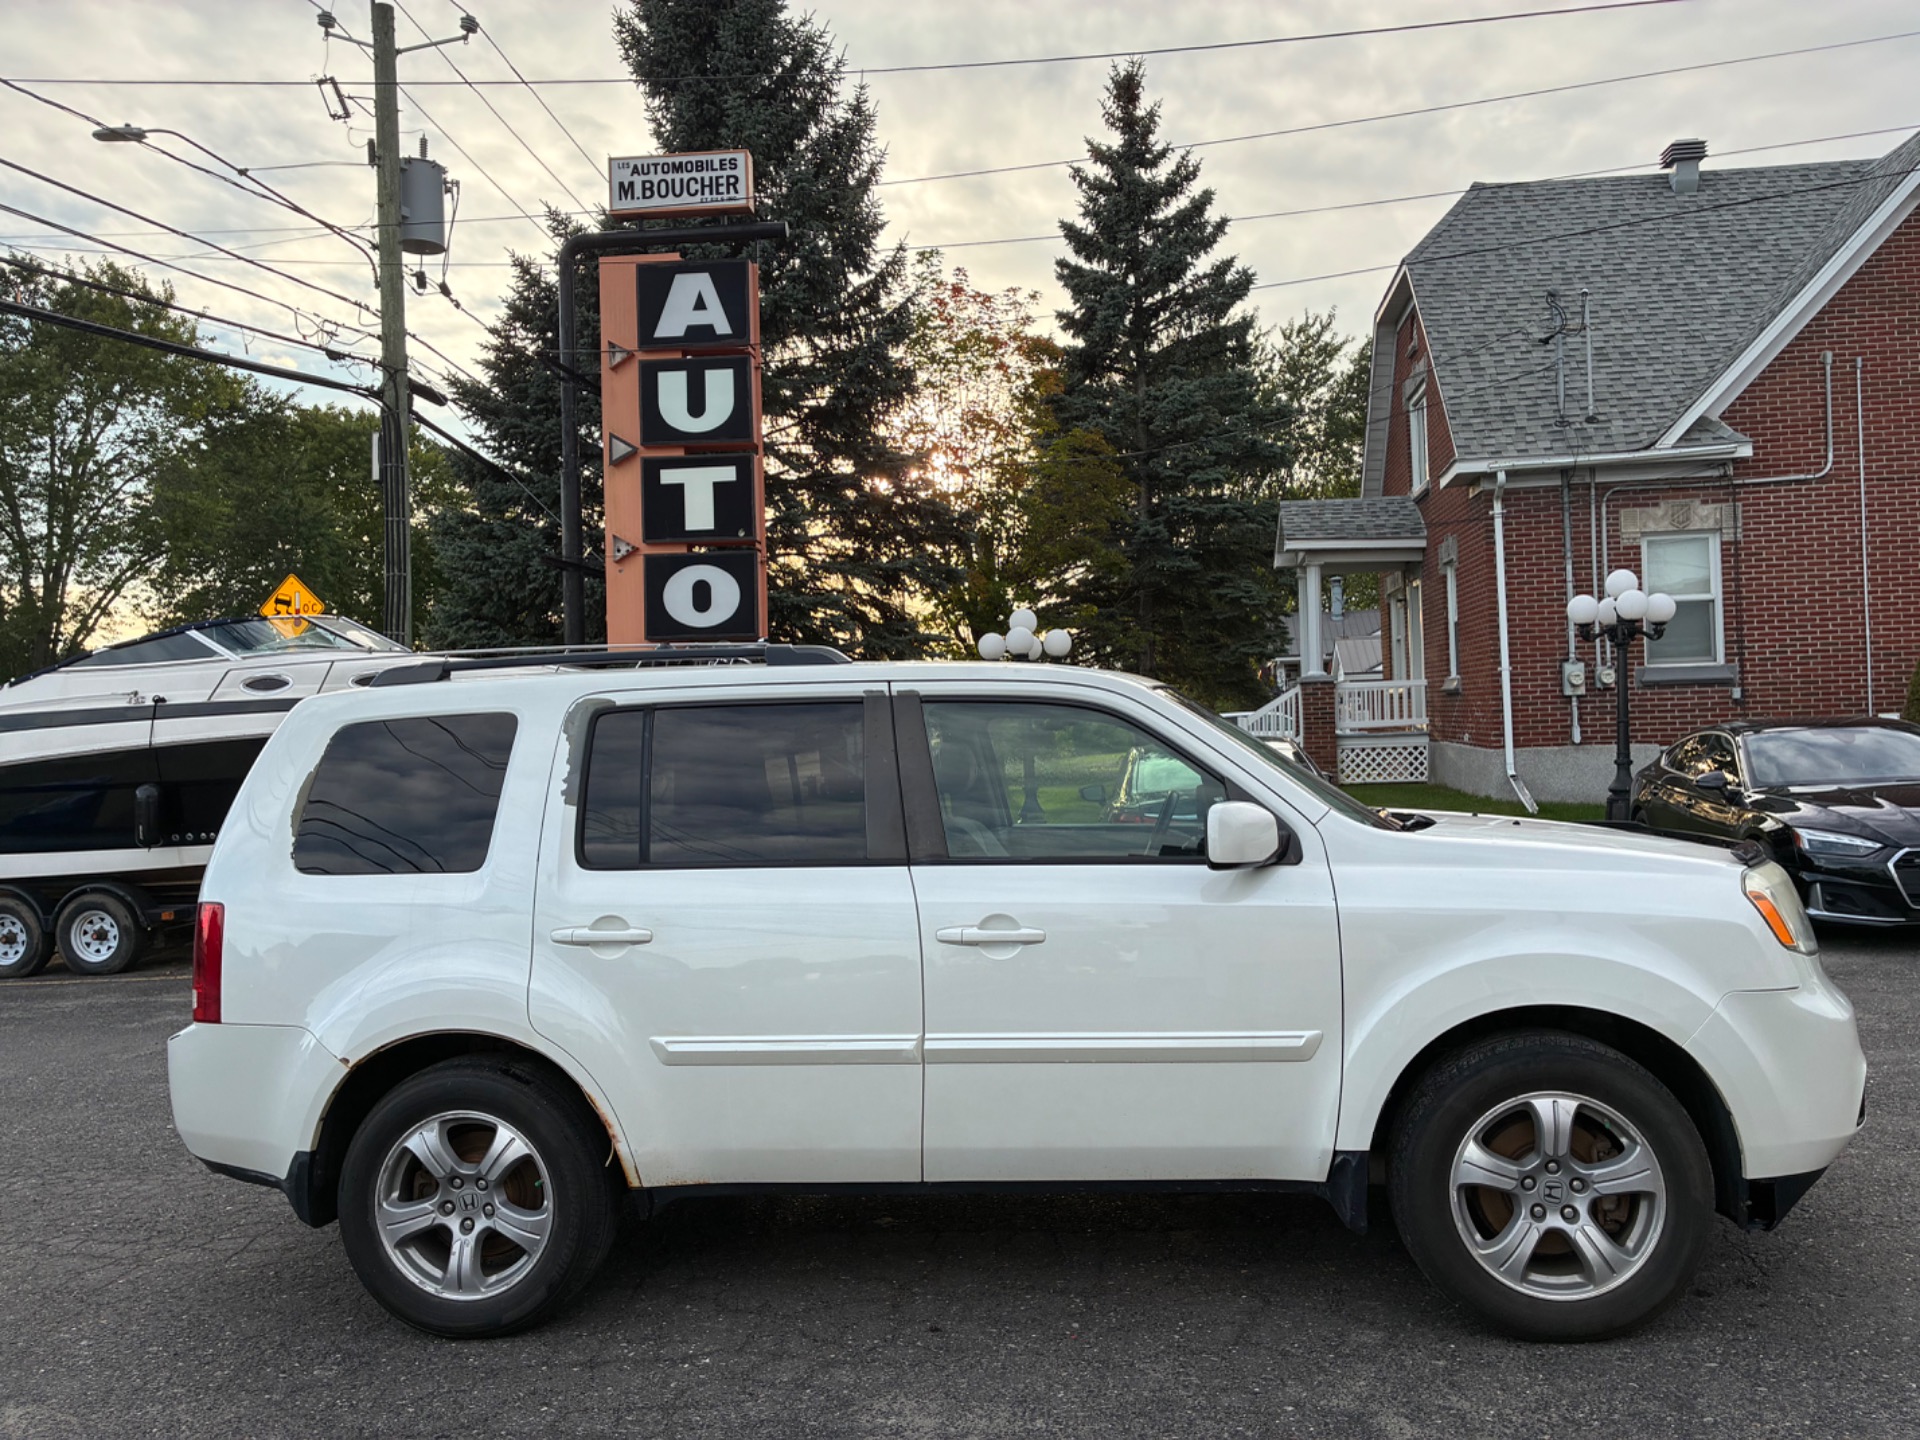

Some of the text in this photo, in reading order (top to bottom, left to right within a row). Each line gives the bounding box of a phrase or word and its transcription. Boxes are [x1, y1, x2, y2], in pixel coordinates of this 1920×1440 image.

[617, 157, 738, 177] LES AUTOMOBILES
[618, 174, 739, 201] M.BOUCHER
[653, 272, 741, 628] AUTO
